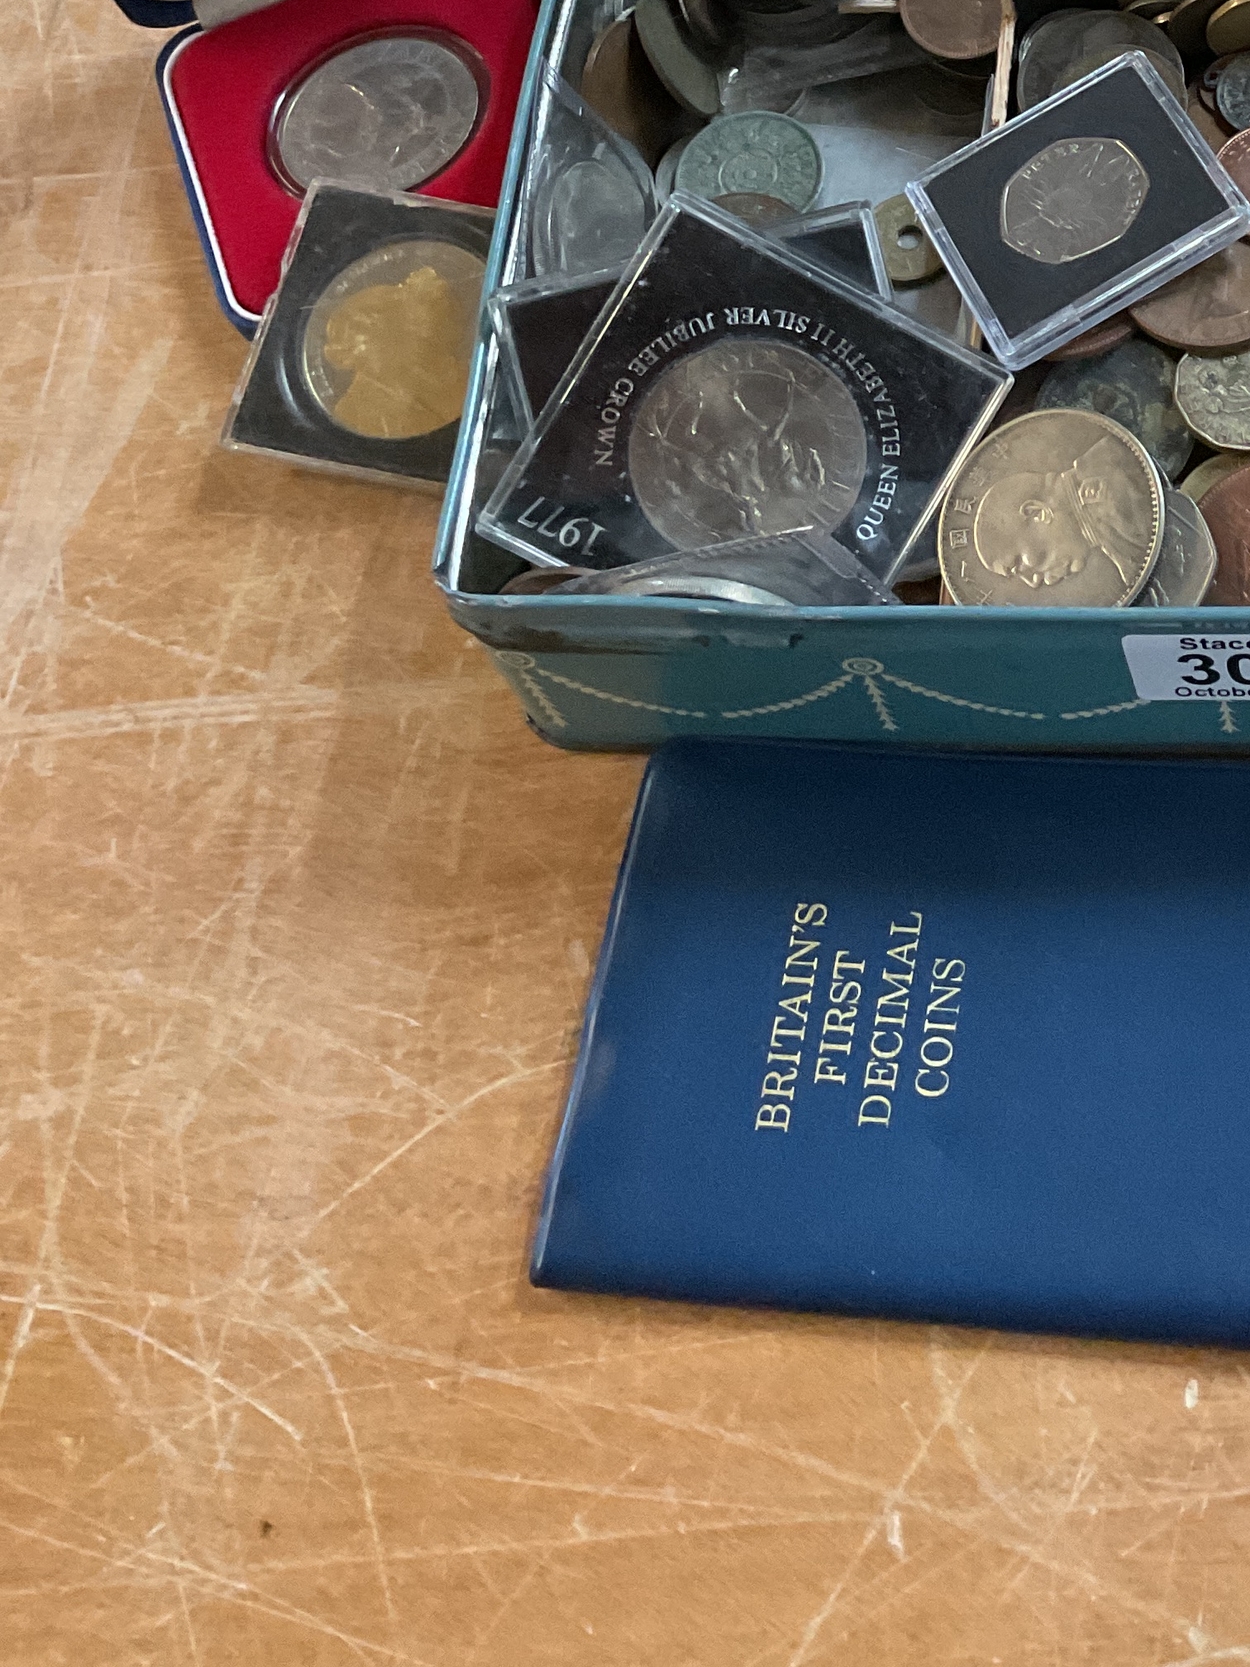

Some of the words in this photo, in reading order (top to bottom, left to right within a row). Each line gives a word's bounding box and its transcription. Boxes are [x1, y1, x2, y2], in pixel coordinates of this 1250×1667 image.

[628, 312, 716, 377] JUBILEE
[723, 306, 812, 334] SILVER
[594, 377, 635, 467] CROWN
[835, 338, 900, 457] ELIZABETH
[517, 495, 608, 557] 1977
[856, 464, 900, 541] QUEEN
[755, 902, 828, 1133] BRITAIN'S
[814, 950, 866, 1085] FIRST
[857, 910, 923, 1129] DECIMAL
[914, 957, 967, 1098] COINS
